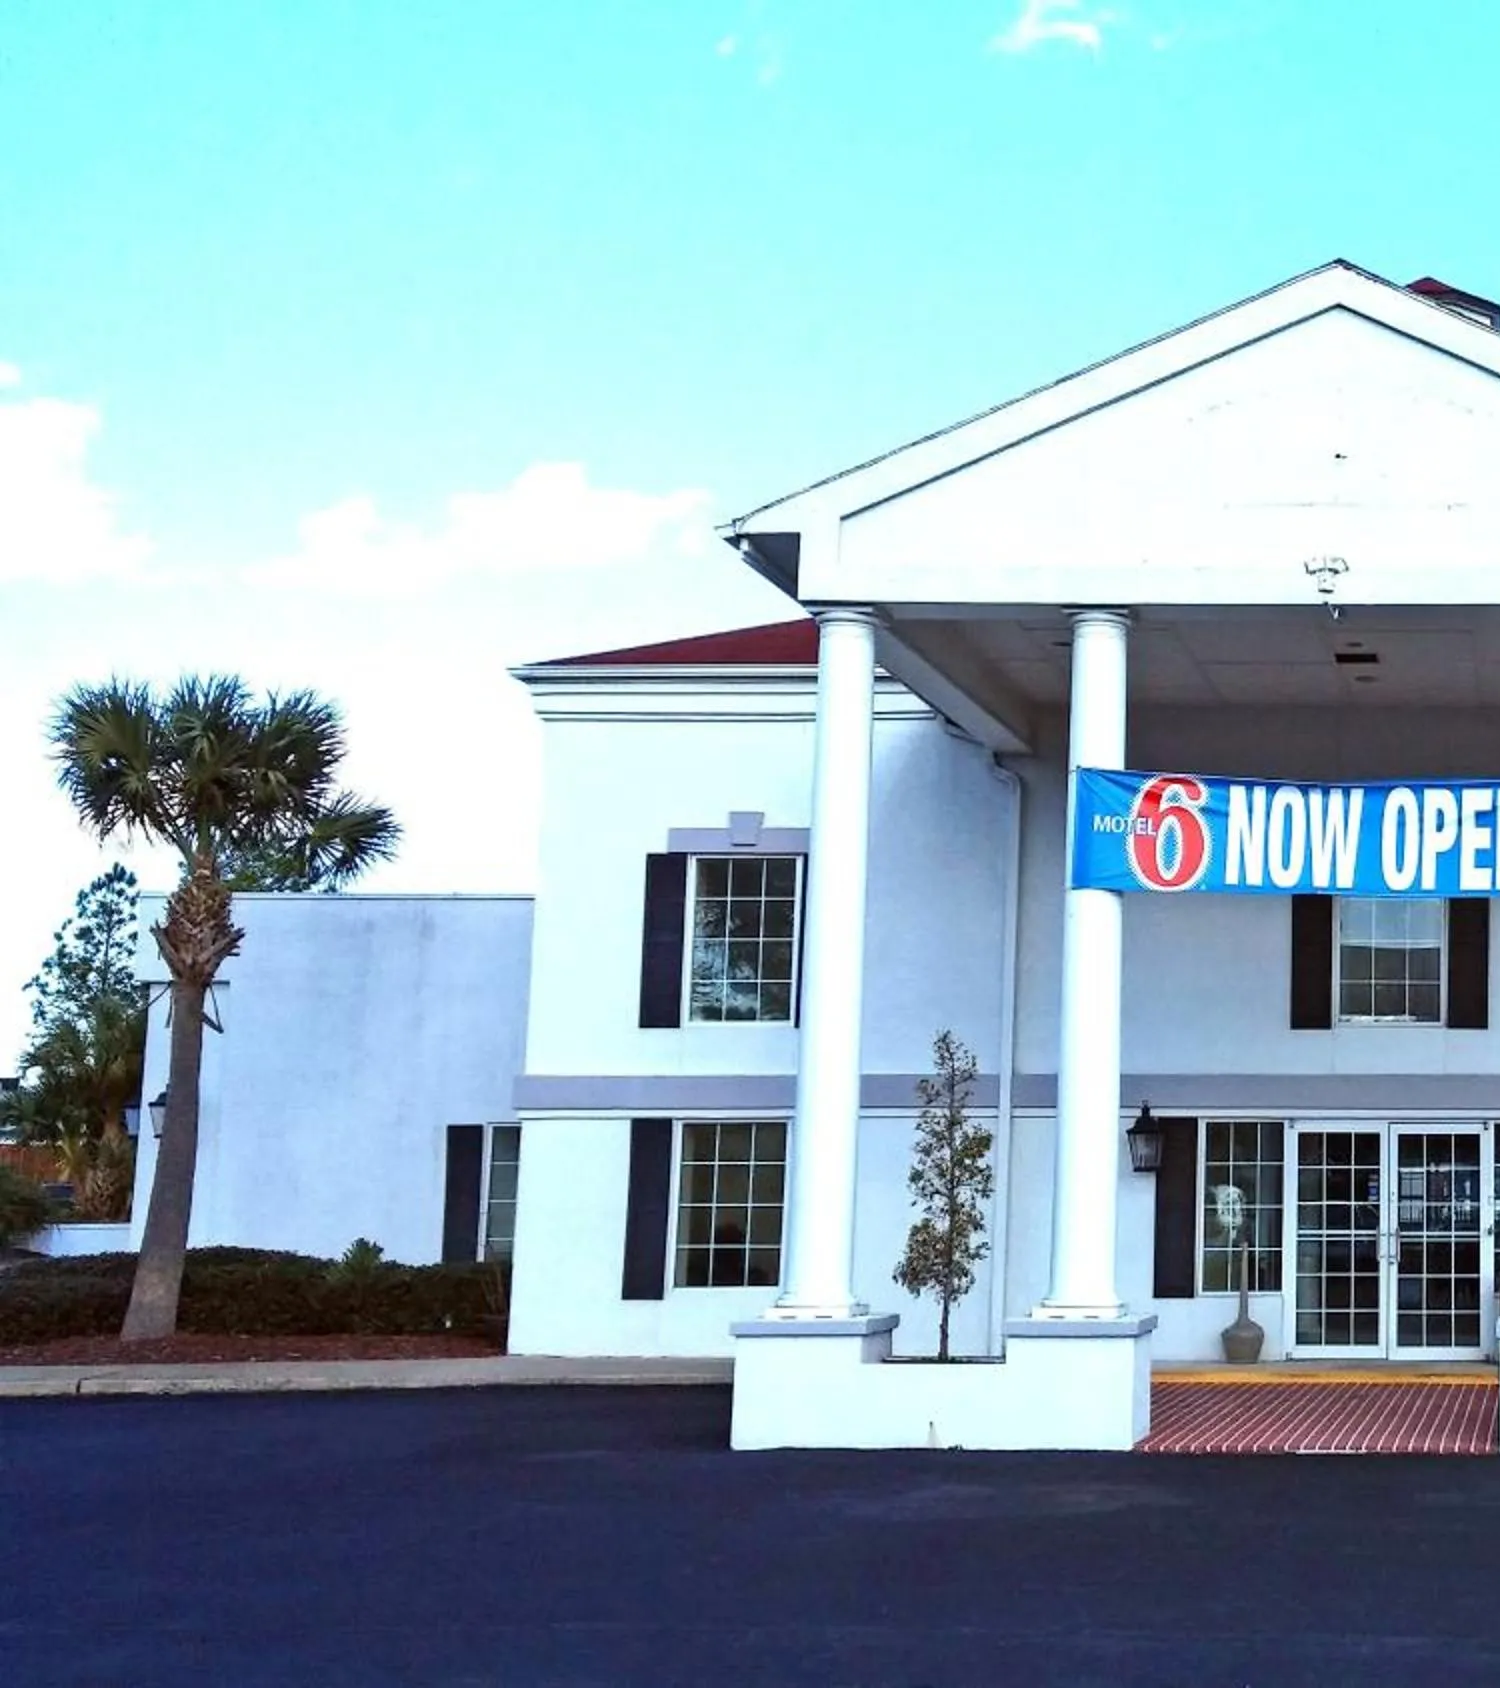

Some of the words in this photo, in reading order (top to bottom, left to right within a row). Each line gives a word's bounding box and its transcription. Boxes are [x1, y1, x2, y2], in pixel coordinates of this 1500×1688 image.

[1093, 814, 1156, 835] MOTEL
[1130, 774, 1209, 890] 6
[1225, 785, 1364, 888] NOW
